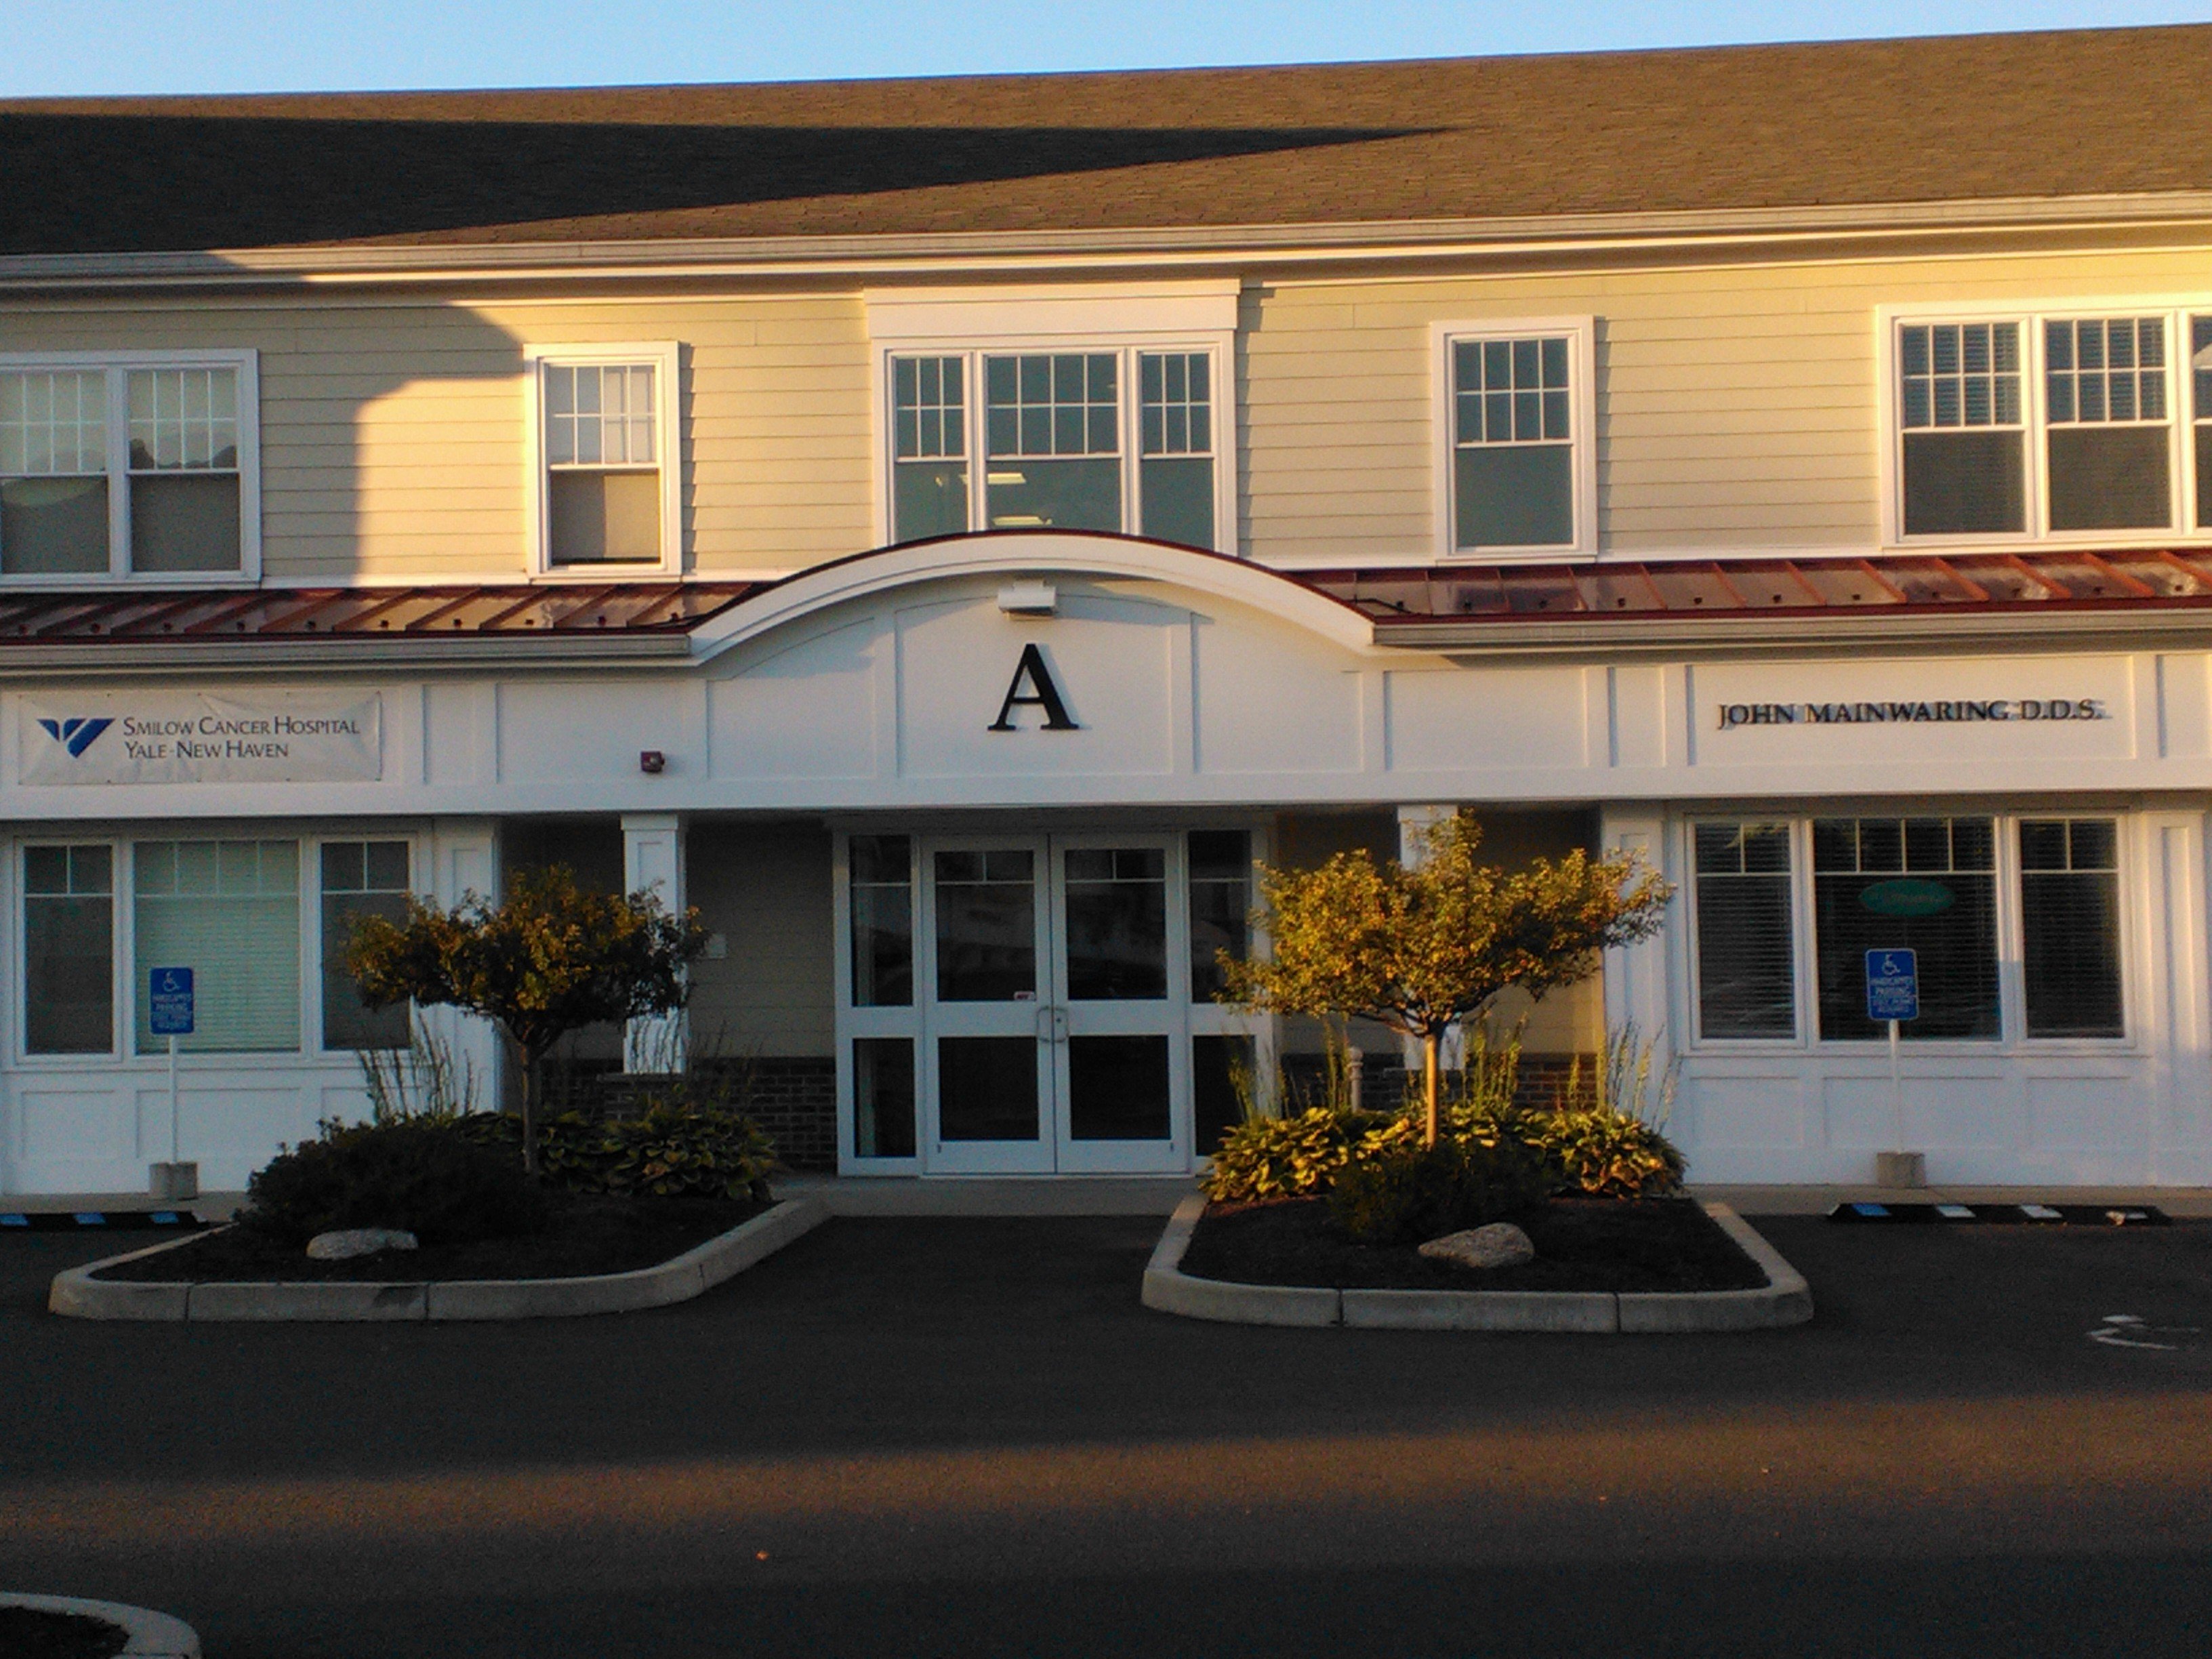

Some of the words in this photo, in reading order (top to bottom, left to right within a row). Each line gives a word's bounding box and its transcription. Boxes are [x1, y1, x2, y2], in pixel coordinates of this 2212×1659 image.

[987, 643, 1080, 731] A
[123, 716, 194, 736] SMILOW
[199, 716, 270, 735] CANCER
[274, 715, 361, 735] HOSPITAL
[1717, 703, 1795, 730] JOHN
[1805, 700, 2009, 724] MAINWARING
[2020, 699, 2102, 720] D.D.S.
[226, 739, 288, 758] HAVEN
